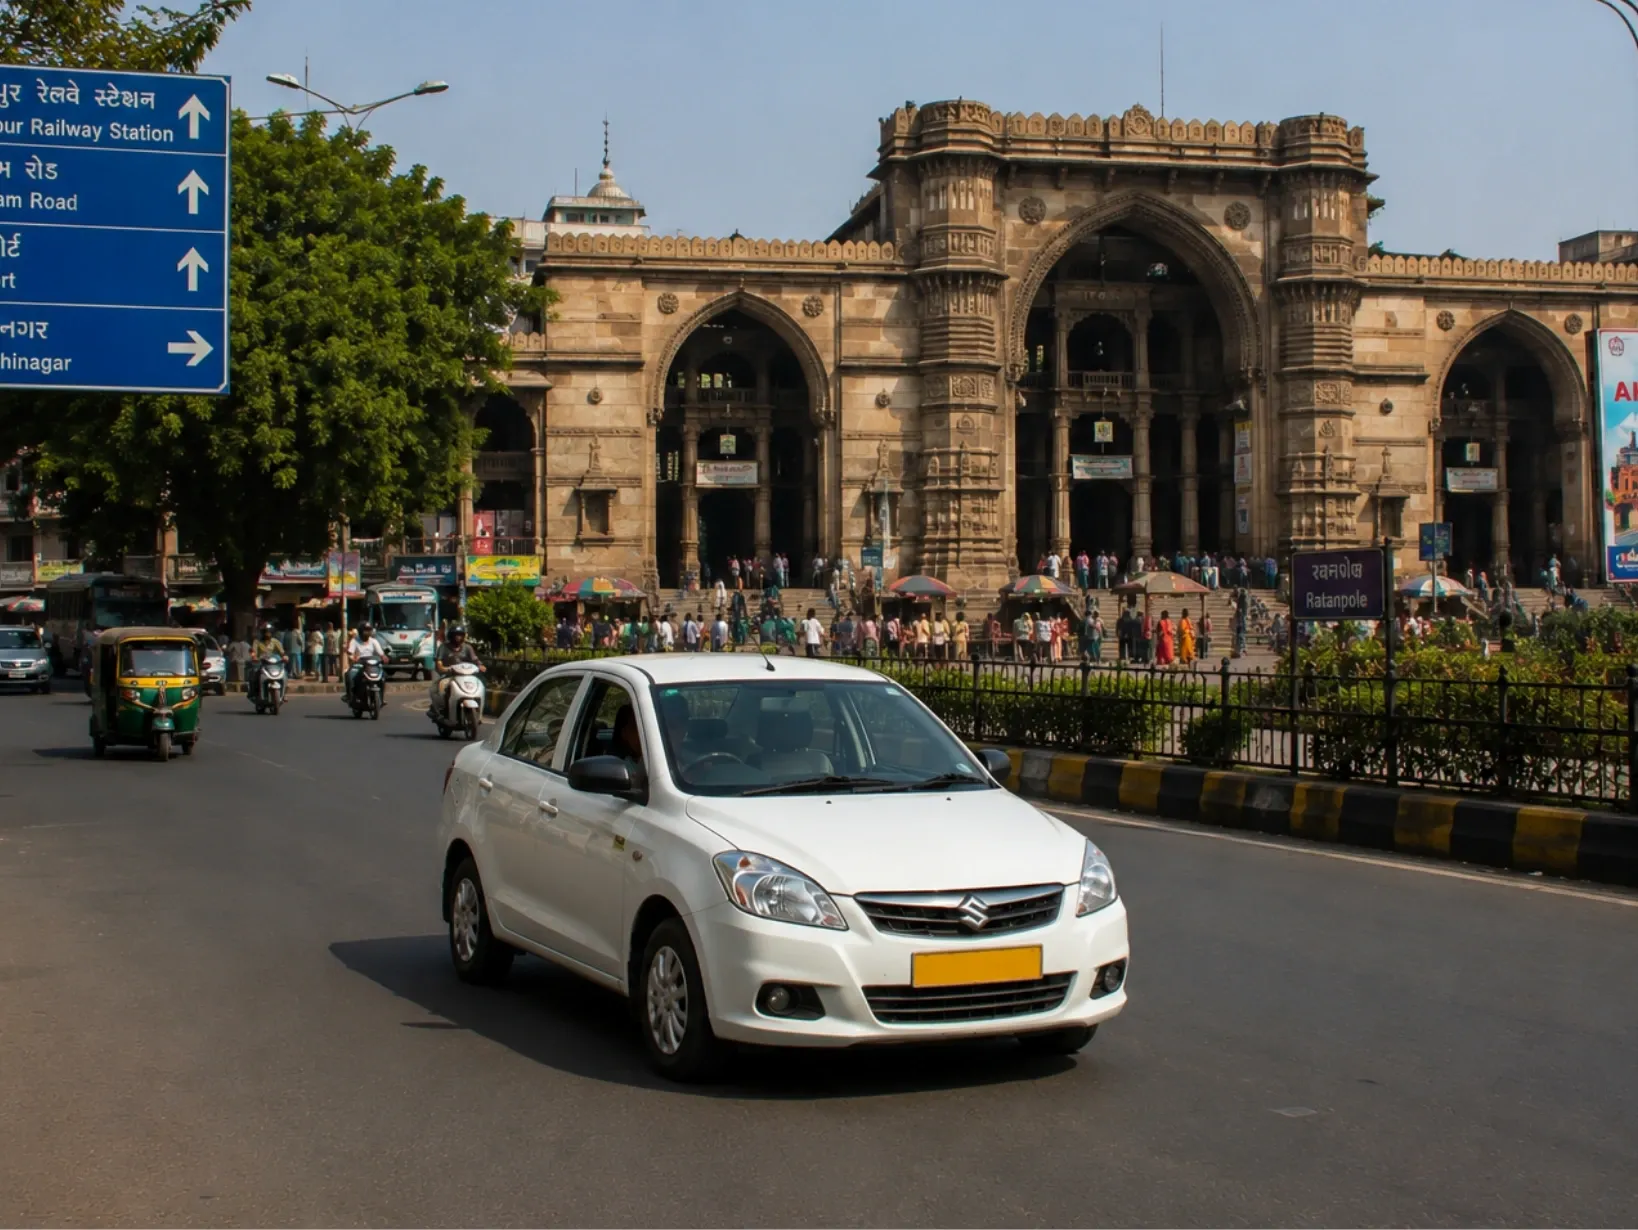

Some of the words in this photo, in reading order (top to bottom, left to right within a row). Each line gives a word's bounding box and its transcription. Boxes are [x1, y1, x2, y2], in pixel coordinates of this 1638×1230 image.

[31, 117, 102, 142] Railway
[109, 122, 174, 143] Station
[30, 191, 78, 211] Road
[0, 352, 72, 375] hinagar
[1305, 588, 1368, 613] Ratanpole
